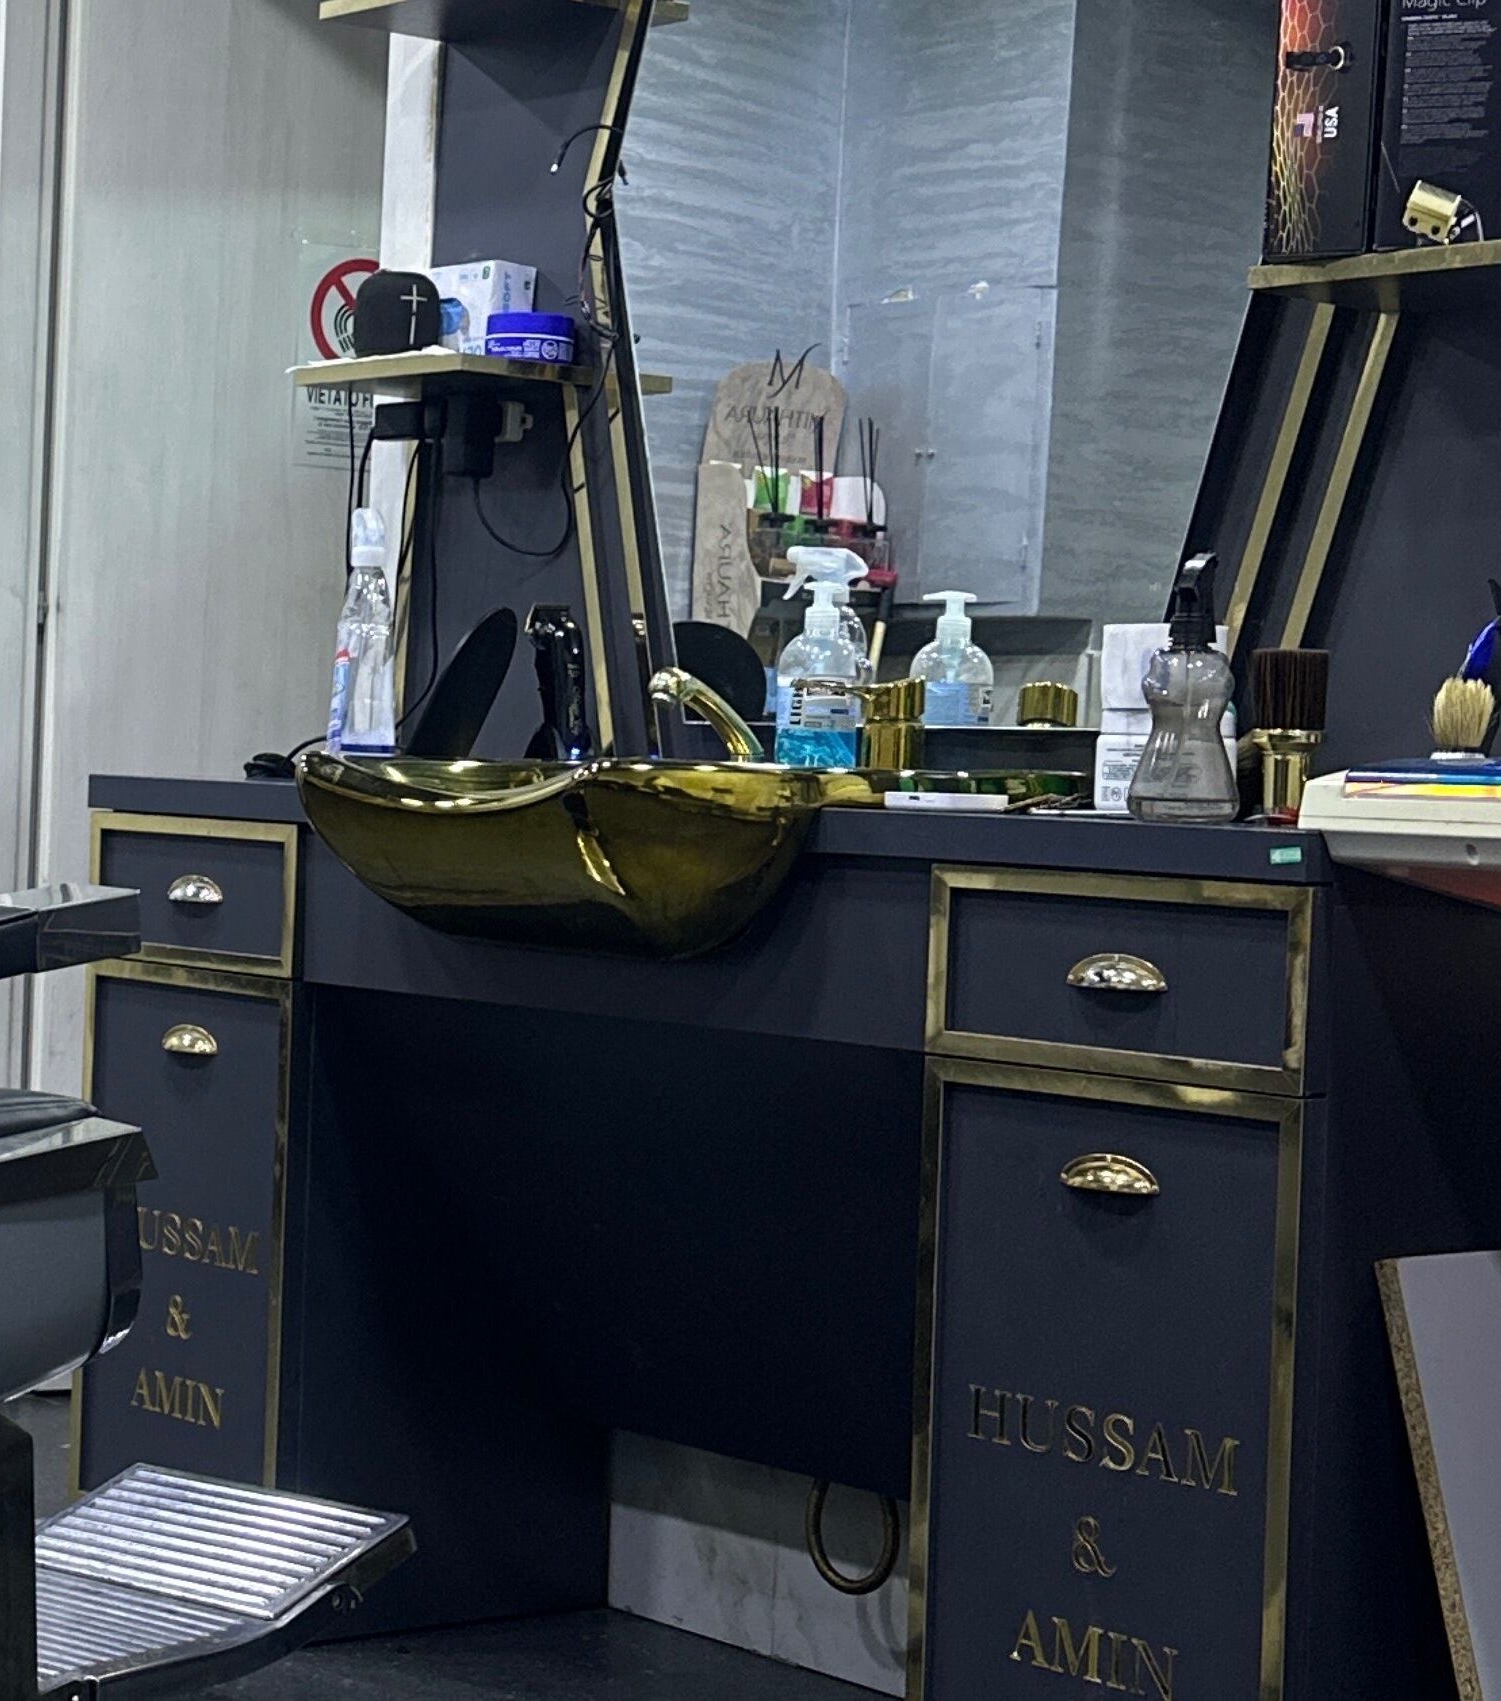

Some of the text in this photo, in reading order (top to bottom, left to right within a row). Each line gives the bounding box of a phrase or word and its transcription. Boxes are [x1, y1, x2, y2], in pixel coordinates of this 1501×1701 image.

[1323, 106, 1339, 138] USA
[136, 1206, 260, 1275] USSAM
[166, 1295, 191, 1340] &
[131, 1367, 225, 1430] AMIN
[967, 1384, 1240, 1496] HUSSAM
[1072, 1516, 1117, 1578] &
[1009, 1609, 1178, 1701] AMIN
